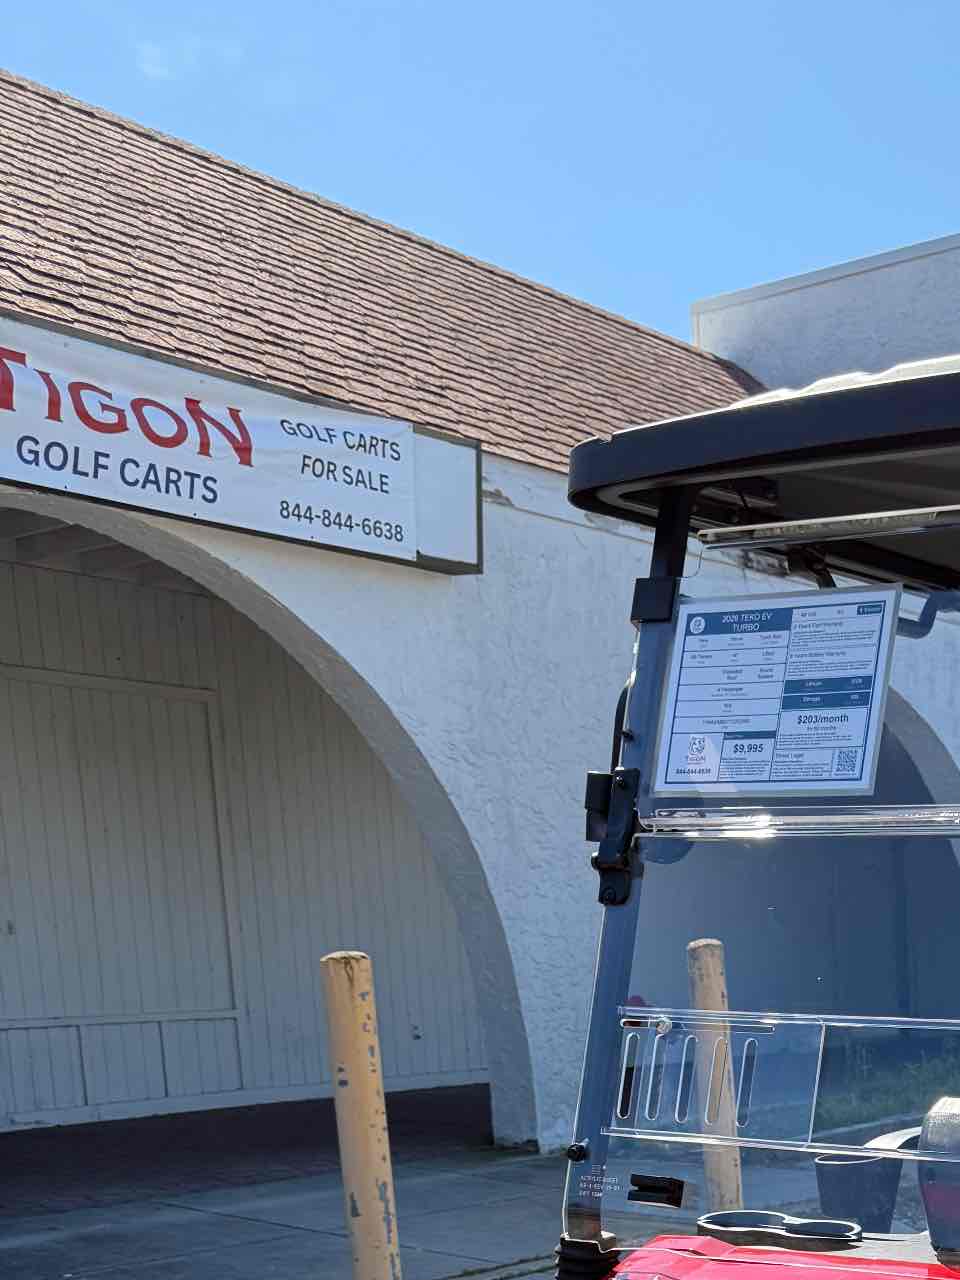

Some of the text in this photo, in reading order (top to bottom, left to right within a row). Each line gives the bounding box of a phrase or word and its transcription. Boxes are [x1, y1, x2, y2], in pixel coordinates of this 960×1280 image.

[280, 418, 402, 461] GOLF CARTS
[16, 434, 219, 504] GOLF CARTS
[300, 454, 391, 495] FOR SALE
[279, 499, 404, 543] 844-844-6638
[797, 714, 849, 725] $203/month
[733, 743, 764, 754] $9,995
